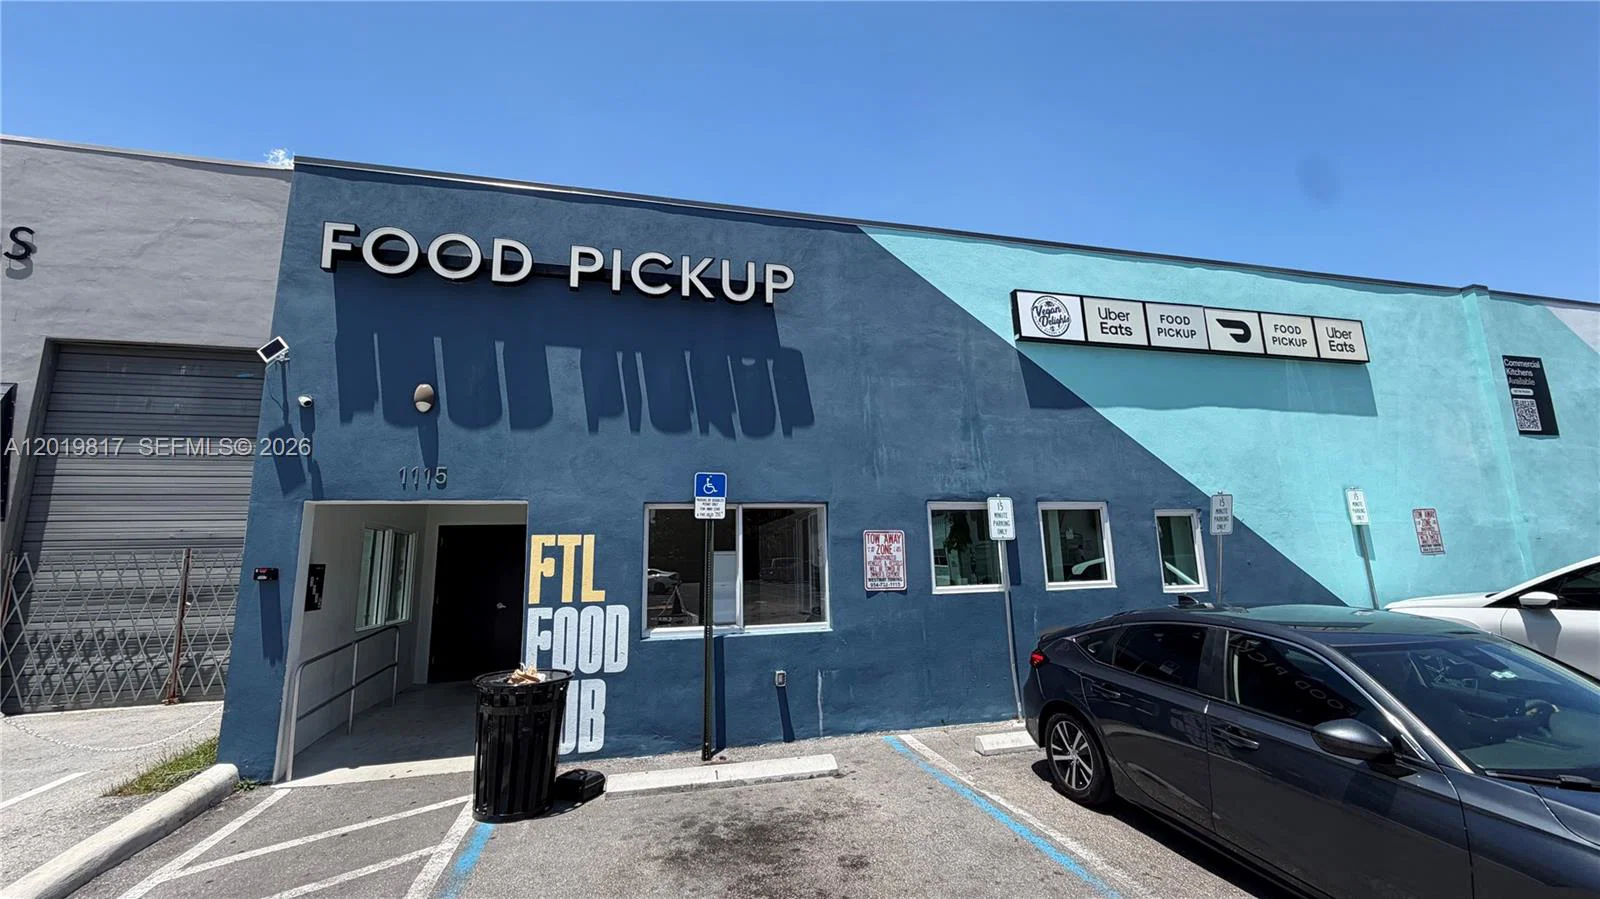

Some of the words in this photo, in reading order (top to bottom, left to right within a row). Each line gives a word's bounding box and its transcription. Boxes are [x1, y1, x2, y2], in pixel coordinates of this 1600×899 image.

[320, 220, 534, 283] FOOD
[569, 244, 796, 304] PICKUP
[1032, 305, 1062, 319] Vegan
[1098, 307, 1131, 323] Uber
[1160, 314, 1191, 326] FOOD
[1100, 323, 1133, 337] Eats
[1157, 327, 1197, 340] PICKUP
[1273, 324, 1302, 335] FOOD
[1325, 326, 1353, 340] Uber
[1272, 336, 1308, 349] PICKUP
[1328, 340, 1356, 354] Eats
[1503, 359, 1541, 369] Commercial
[1506, 368, 1534, 377] Kitchens
[1508, 377, 1536, 387] Available
[398, 466, 448, 485] 1115
[996, 502, 1004, 511] 15
[1219, 498, 1225, 507] 15
[867, 533, 880, 544] TOW
[884, 533, 902, 544] AWAY
[875, 544, 893, 555] ZONE
[528, 534, 606, 604] FTL
[525, 604, 630, 674] FOOD
[558, 678, 606, 755] UB
